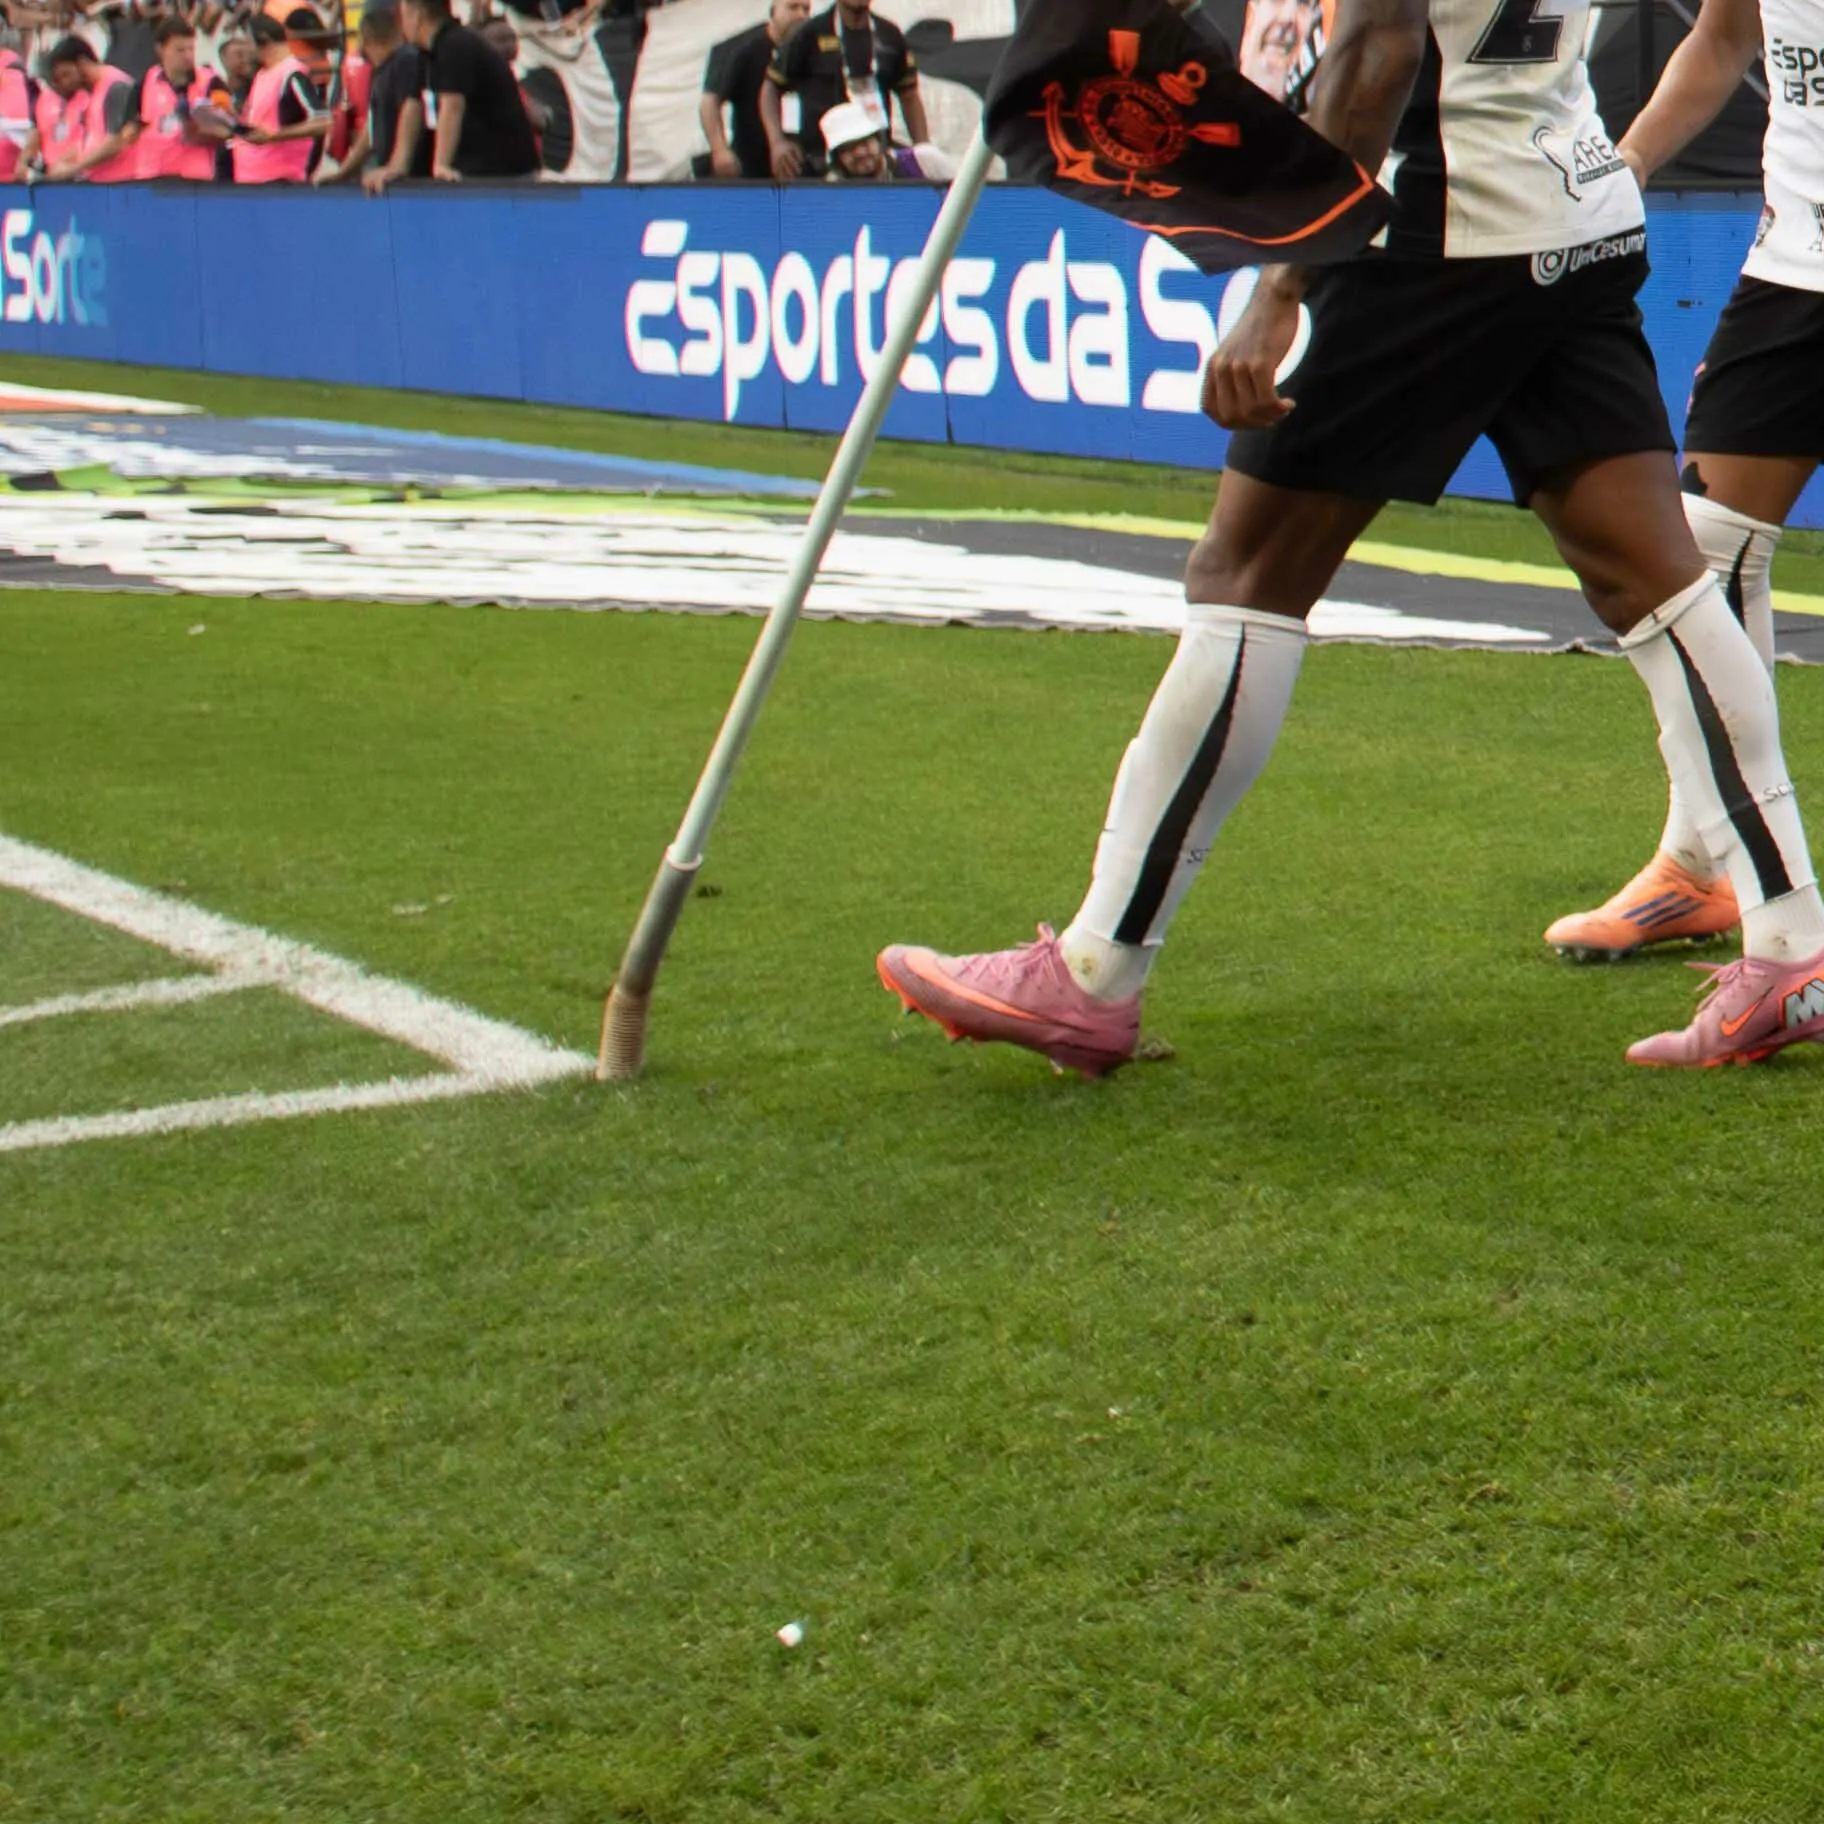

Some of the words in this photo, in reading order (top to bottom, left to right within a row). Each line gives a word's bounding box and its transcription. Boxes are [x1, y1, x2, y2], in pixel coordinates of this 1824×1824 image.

[2, 208, 108, 327] Sorte
[625, 219, 998, 422] Esportes
[1007, 227, 1131, 407] da
